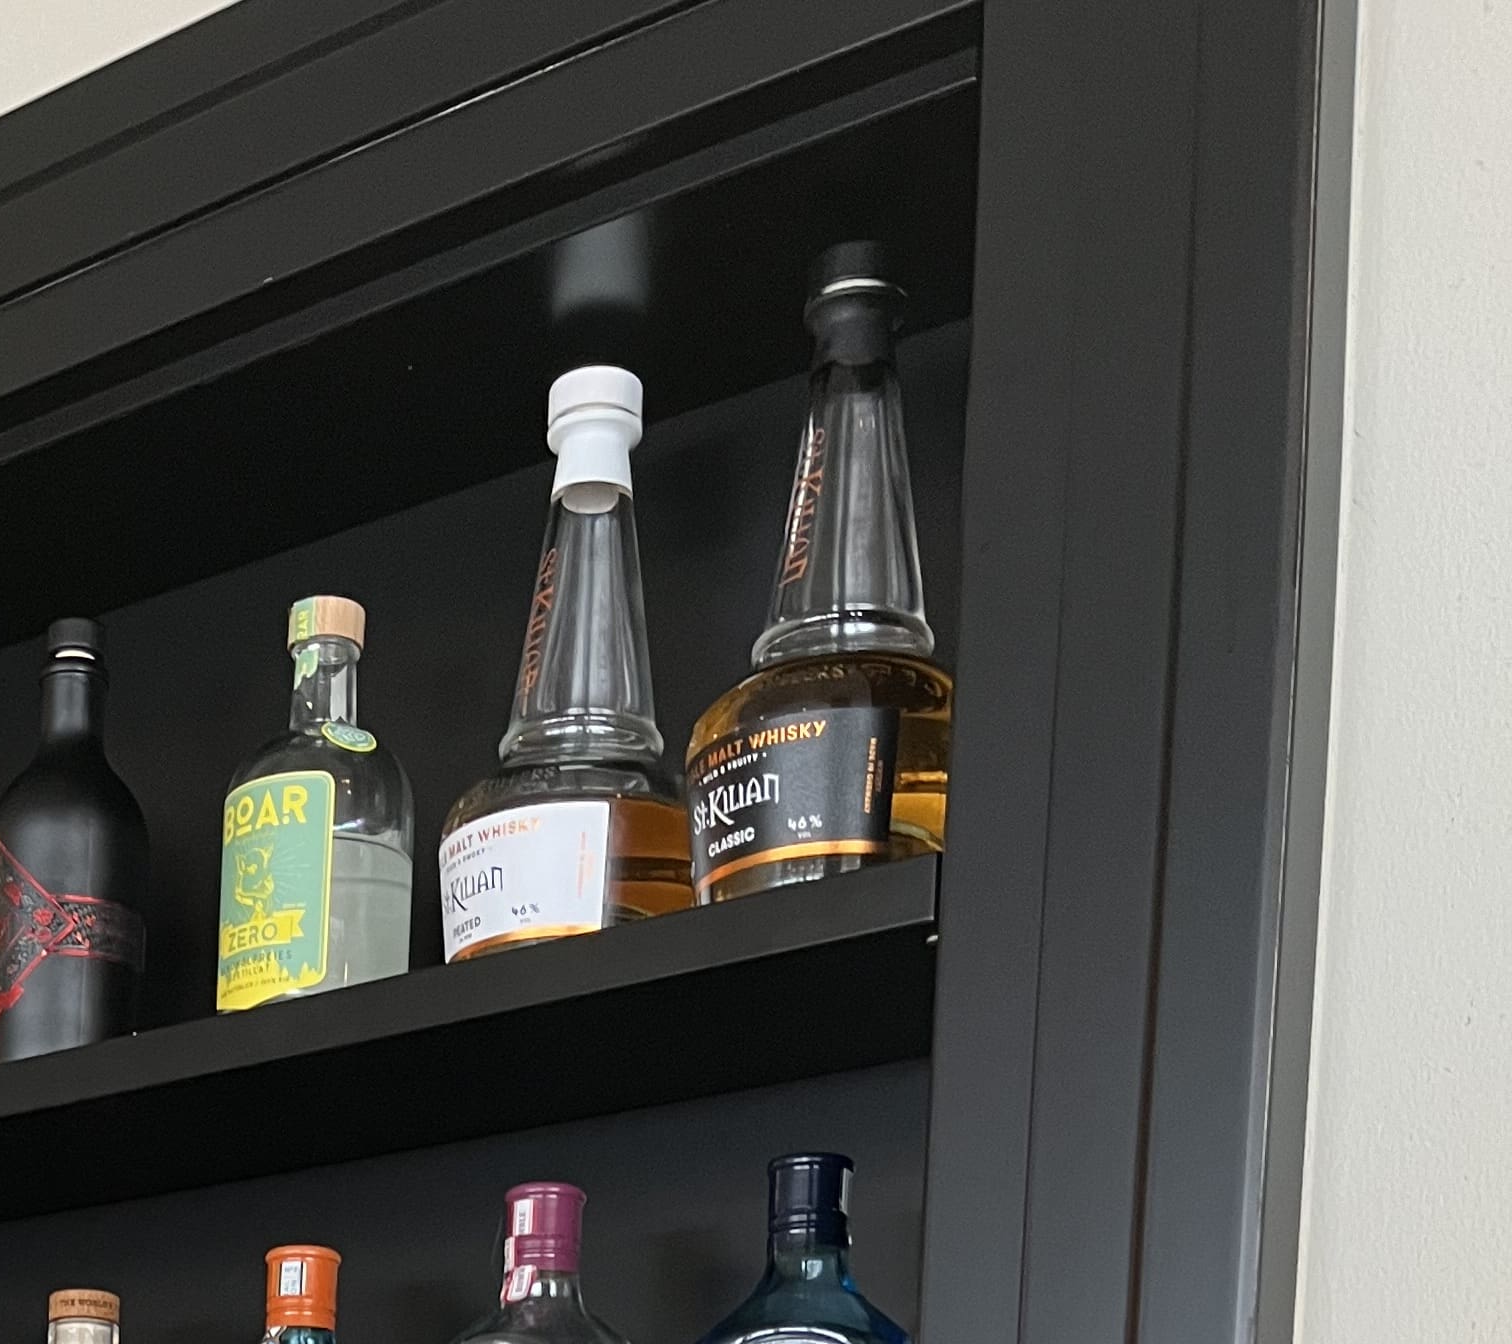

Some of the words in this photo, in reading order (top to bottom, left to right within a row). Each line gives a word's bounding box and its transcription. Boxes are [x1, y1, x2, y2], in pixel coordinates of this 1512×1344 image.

[708, 738, 744, 766] MALT
[748, 720, 827, 750] WHISKY
[224, 785, 308, 846] BOAR
[448, 834, 473, 859] MALT
[478, 817, 541, 843] WHISKY
[708, 826, 755, 858] CLASSIC
[228, 923, 278, 951] ZERO
[453, 916, 481, 939] PEATED
